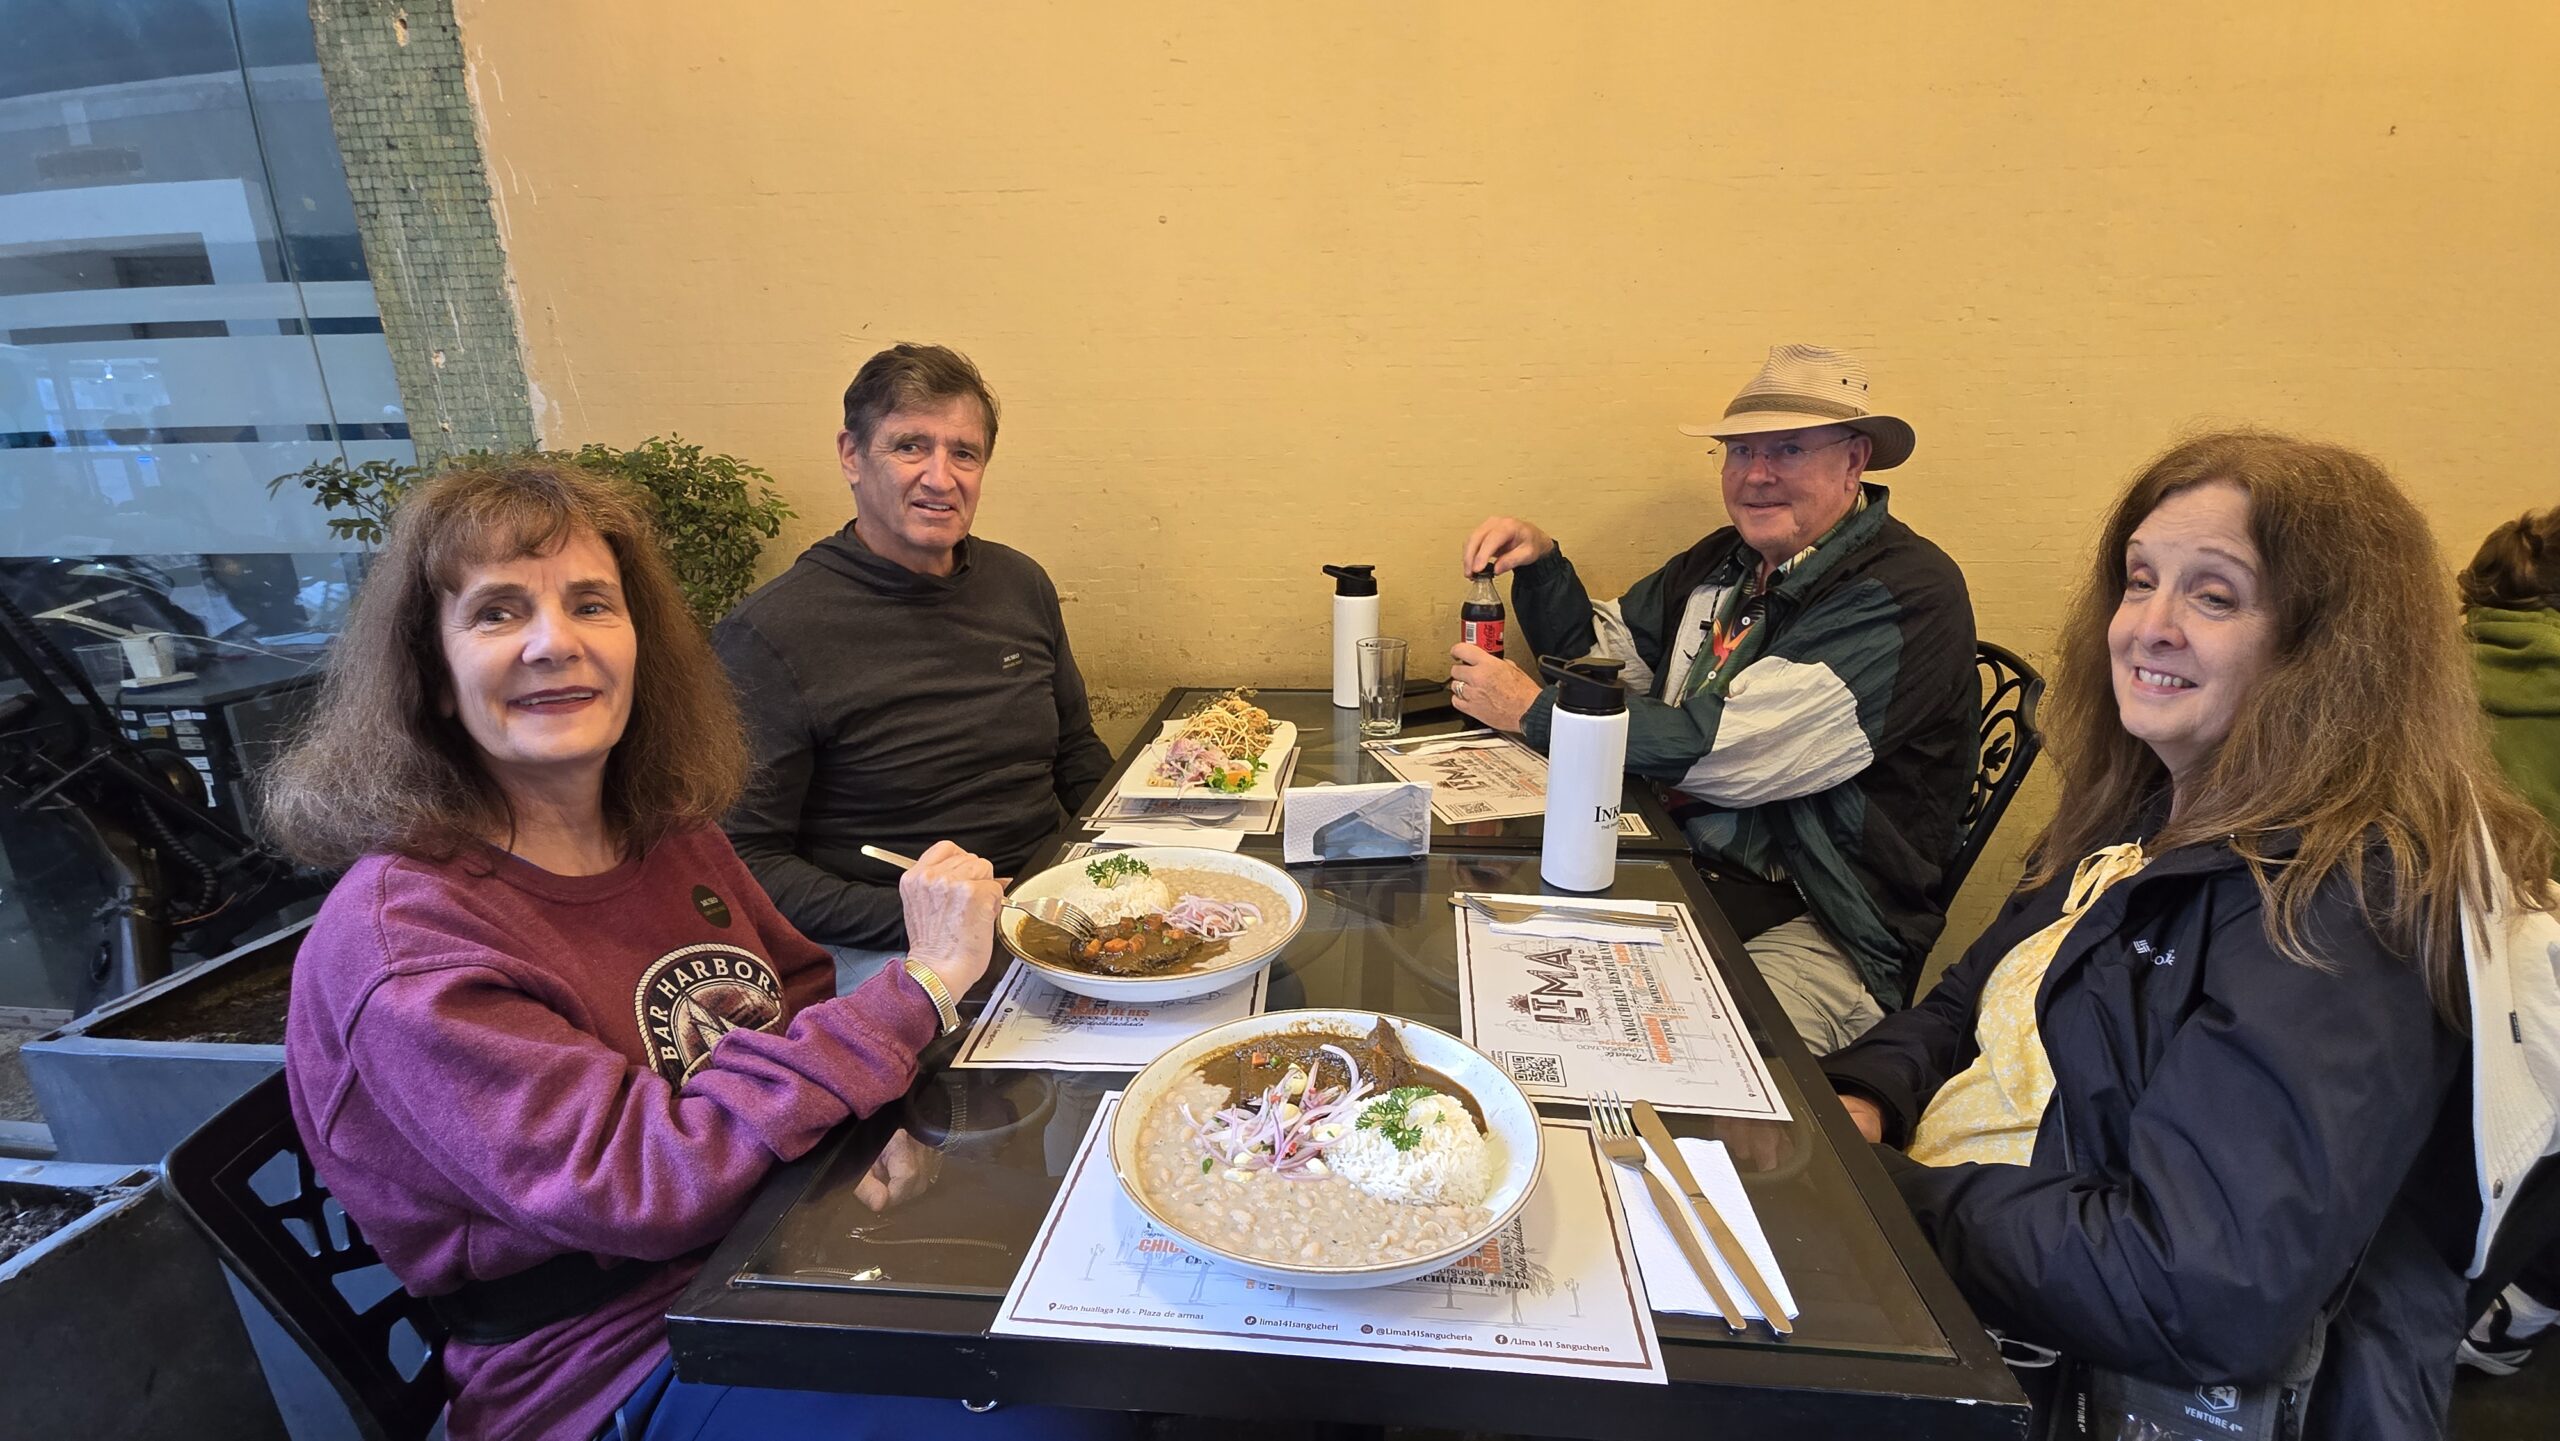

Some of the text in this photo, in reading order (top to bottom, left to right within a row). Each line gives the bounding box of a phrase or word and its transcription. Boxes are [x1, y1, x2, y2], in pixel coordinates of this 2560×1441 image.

[1520, 945, 1593, 1026] LIMA
[1127, 1009, 1151, 1017] RES
[650, 1005, 678, 1061] BAR
[1503, 1244, 1515, 1279] PAPAS
[1514, 1257, 1528, 1281] Pollo
[1432, 1268, 1484, 1278] urguesa
[1490, 1280, 1530, 1290] POLLO
[1080, 1305, 1114, 1315] huallaga
[1116, 1307, 1131, 1316] 146
[1138, 1308, 1161, 1318] Plaza
[1163, 1310, 1176, 1318] de
[1177, 1312, 1205, 1320] armas
[1539, 1339, 1553, 1348] 141
[2184, 1405, 2228, 1430] VENTURE
